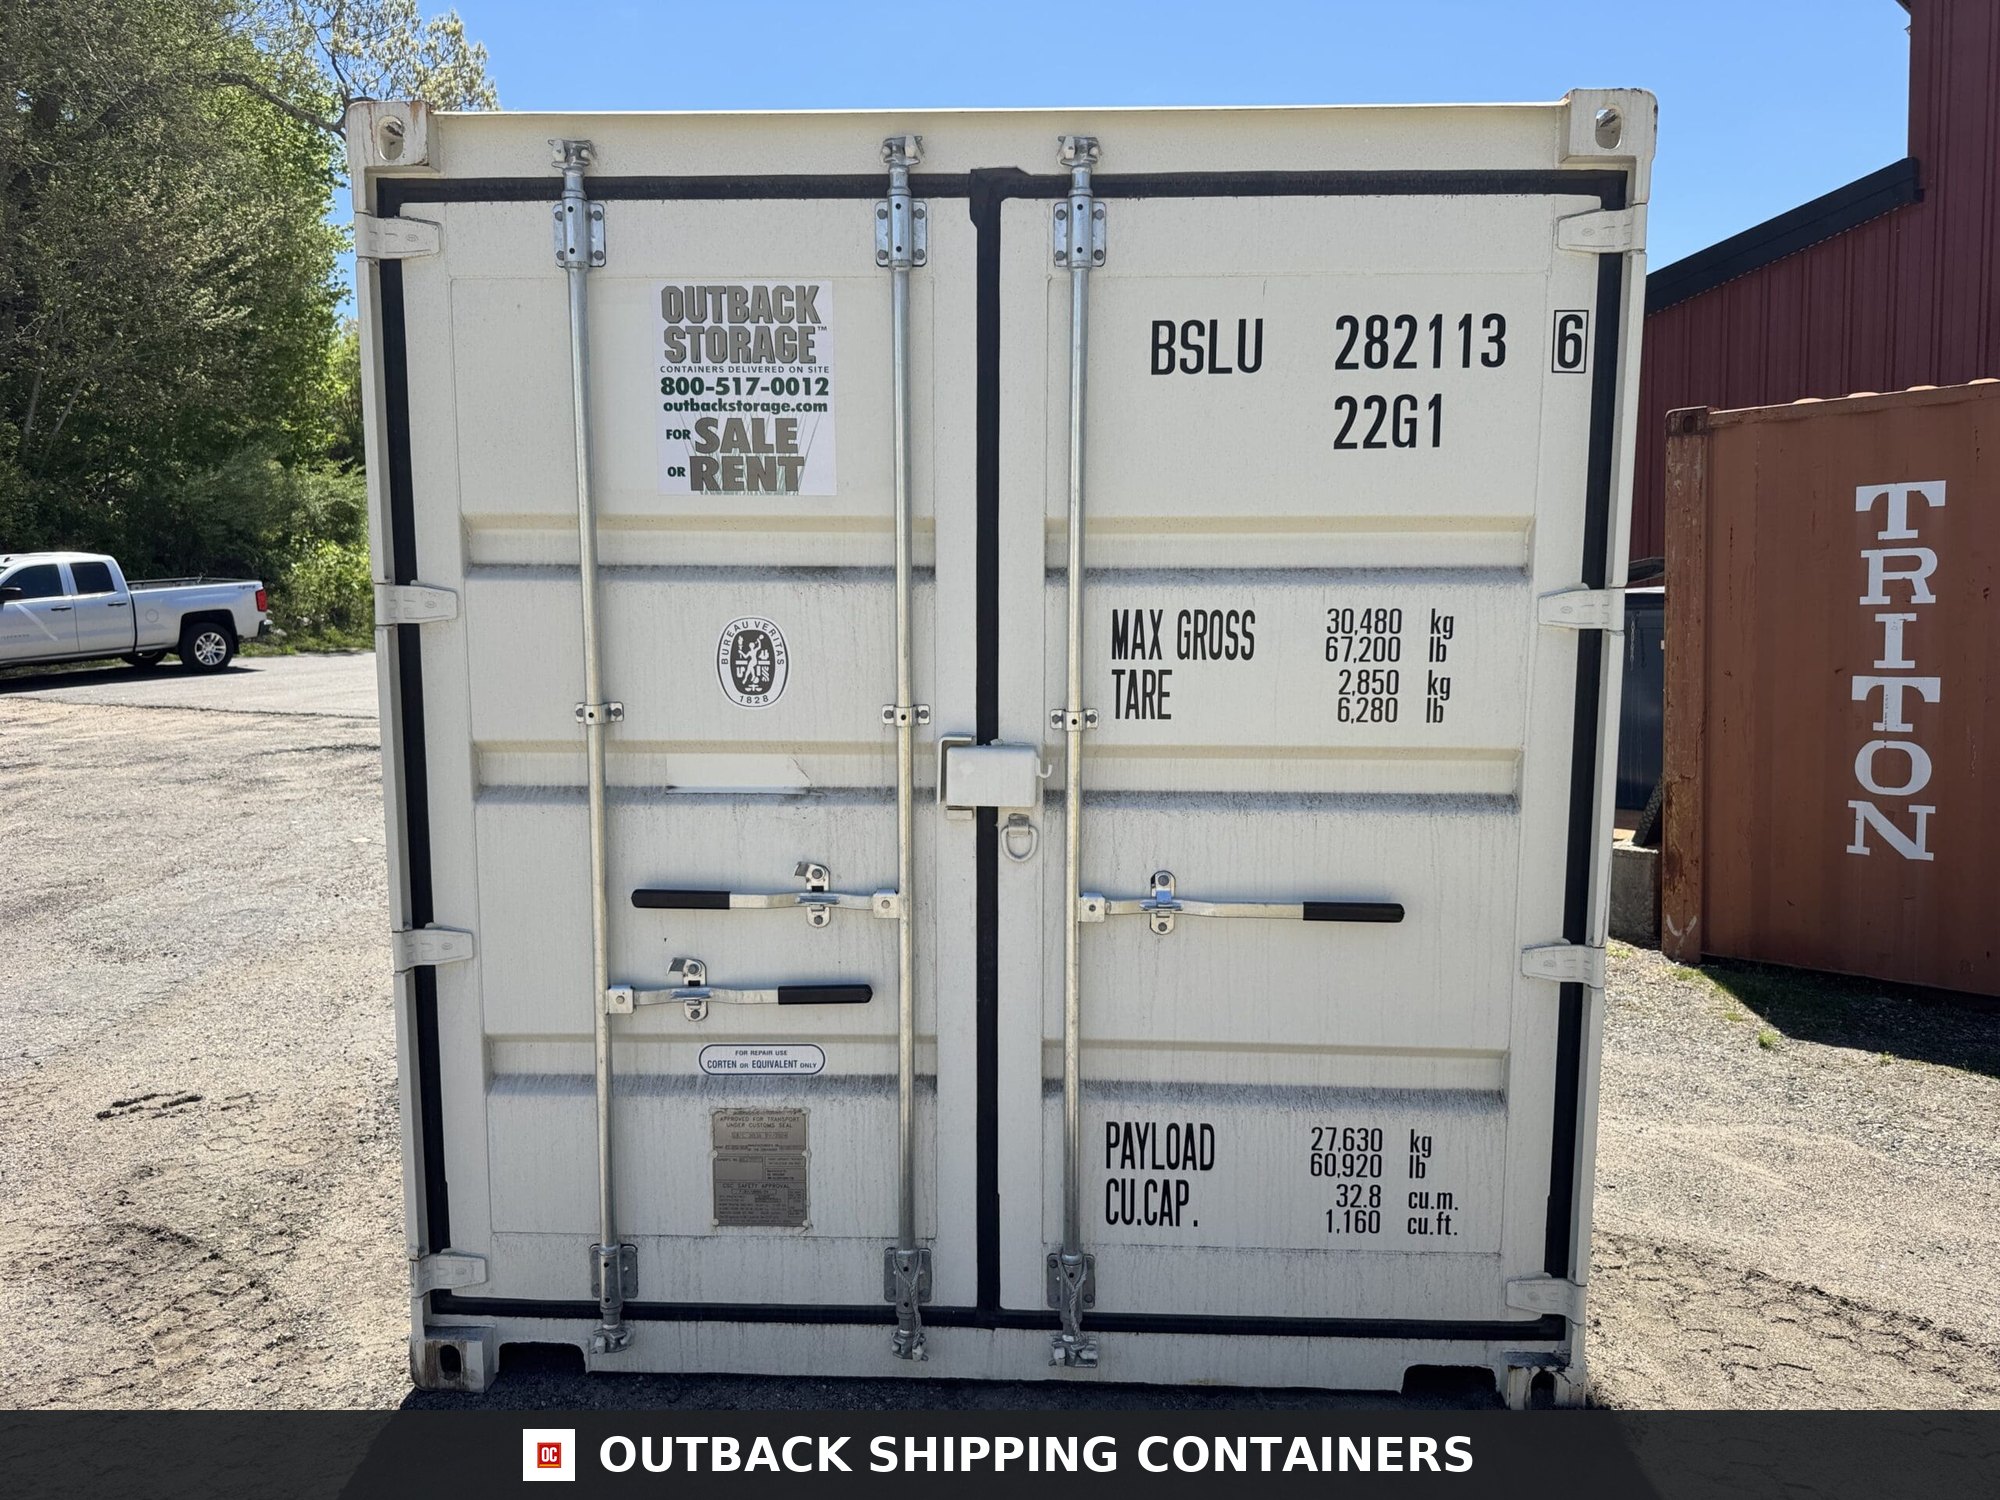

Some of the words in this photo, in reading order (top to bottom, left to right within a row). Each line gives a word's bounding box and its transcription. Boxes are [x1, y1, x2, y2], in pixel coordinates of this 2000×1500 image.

[661, 286, 821, 324] OUTBACK
[664, 326, 816, 363] STORAGE
[1151, 318, 1263, 375] BSLU
[1334, 313, 1506, 370] 282113
[1557, 313, 1583, 369] 6
[660, 377, 829, 396] 800-517-0012
[663, 398, 828, 414] outbackstorage.com
[1333, 393, 1442, 449] 22G1
[666, 429, 691, 440] FOR
[694, 417, 799, 453] SALE
[667, 467, 686, 477] OR
[689, 456, 805, 492] RENT
[1111, 609, 1163, 660] MAX
[1177, 609, 1256, 661] GROSS
[1327, 608, 1402, 636] 30,480
[1430, 608, 1454, 640] kg
[721, 621, 749, 665] BUREAU
[754, 621, 784, 665] VERITAS
[1325, 636, 1401, 663] 67,200
[1429, 637, 1447, 662] lb
[1338, 669, 1399, 696] 2,850
[1427, 669, 1451, 701] kg
[1846, 480, 1946, 861] TRITON
[740, 695, 769, 704] 1828
[1111, 669, 1173, 720] TARE
[1337, 697, 1398, 724] 6,280
[1426, 698, 1444, 723] lb
[707, 1060, 737, 1069] CORTEN
[751, 1060, 798, 1069] EQUIVALENT
[1106, 1121, 1215, 1171] PAYLOAD
[1311, 1127, 1383, 1153] 27,630
[1410, 1129, 1432, 1158] kg
[1310, 1153, 1382, 1178] 60,920
[1409, 1155, 1426, 1179] lb
[1336, 1184, 1381, 1209] 32.8
[1408, 1190, 1459, 1211] cu.m.
[1326, 1209, 1381, 1235] 1,160
[1407, 1212, 1458, 1236] cu.ft.
